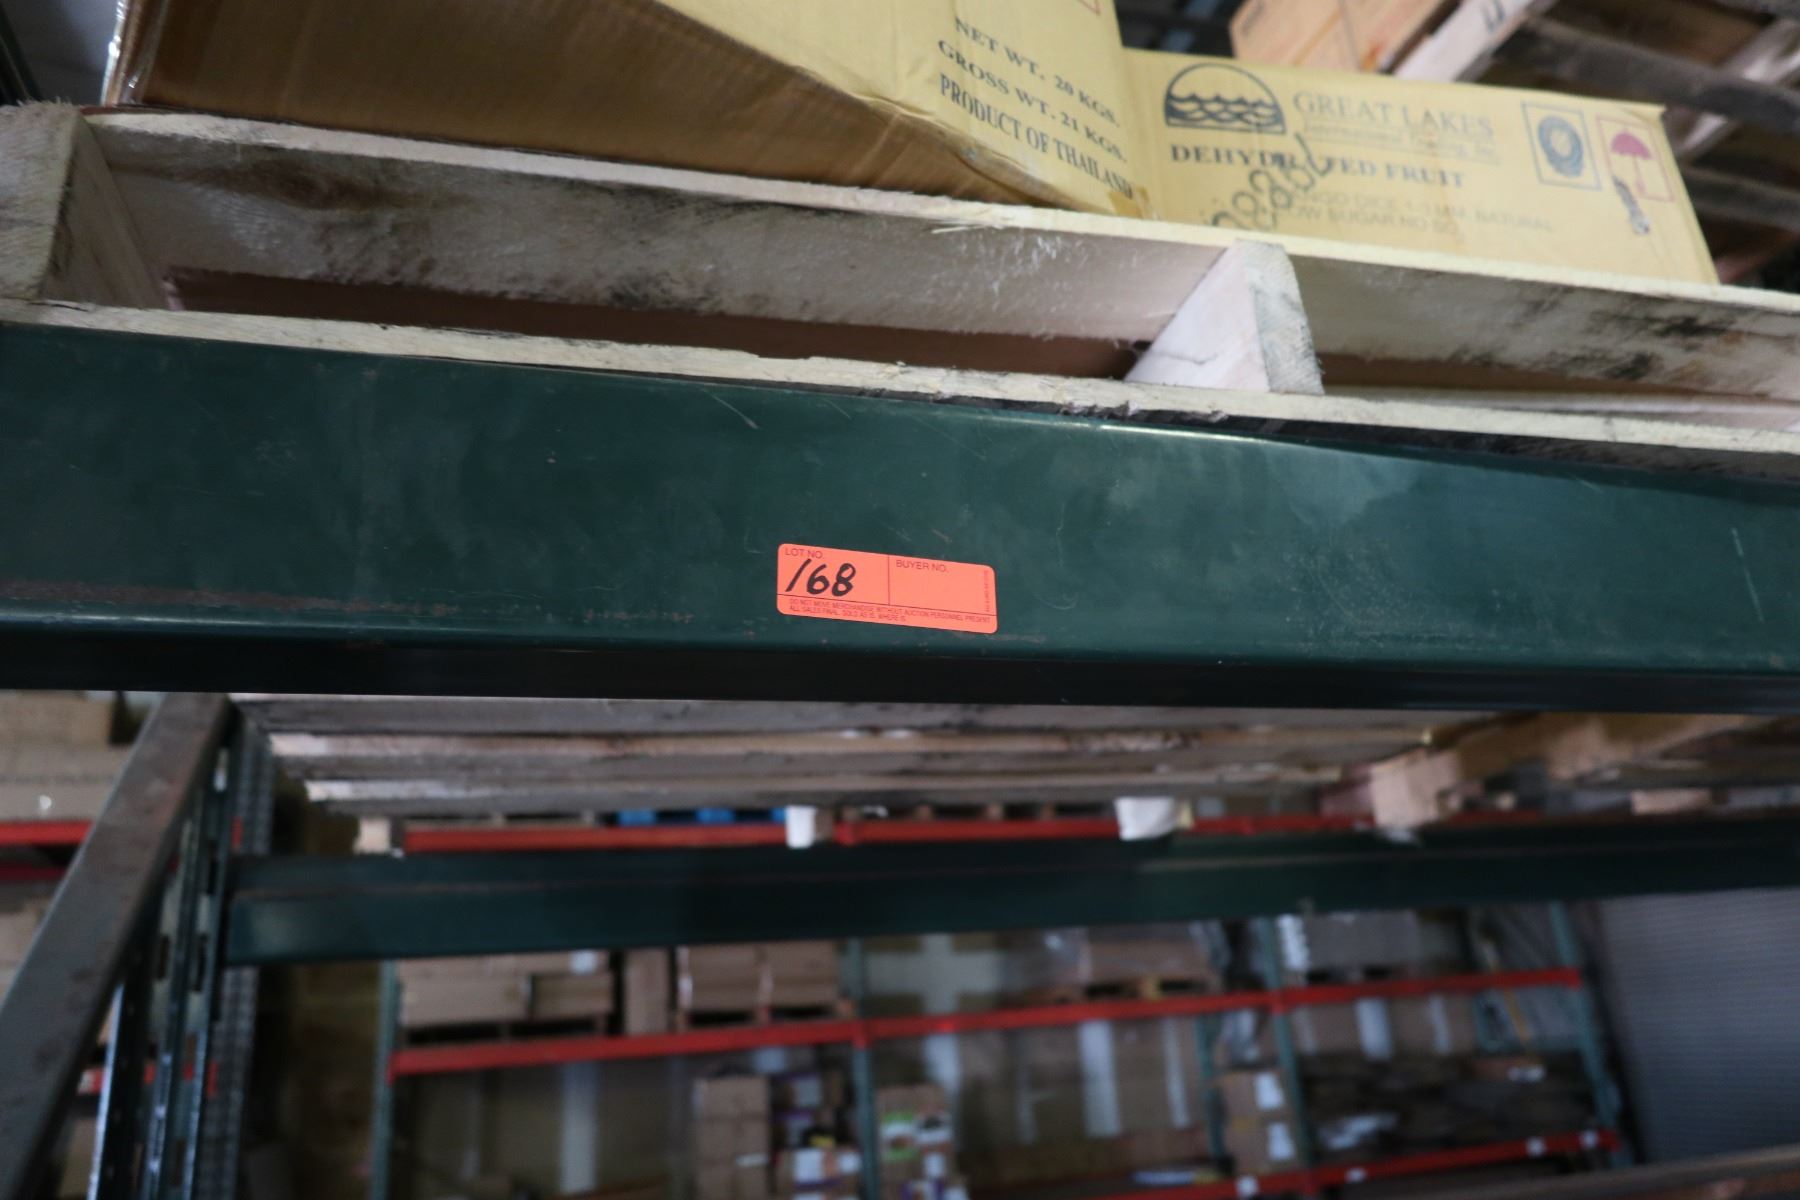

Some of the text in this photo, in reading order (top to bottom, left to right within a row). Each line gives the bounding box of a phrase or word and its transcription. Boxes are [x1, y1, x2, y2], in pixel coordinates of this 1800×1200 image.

[954, 17, 998, 52] NET
[1004, 47, 1045, 81] WT.
[938, 40, 1010, 95] GROSS
[1015, 87, 1056, 119] WT.
[1060, 111, 1079, 132] 21
[939, 73, 1134, 199] PRODUCT OF THAILAND
[1293, 91, 1494, 139] GREAT LAKES
[1384, 164, 1465, 187] FRUIT
[785, 547, 805, 557] LOT
[896, 559, 949, 573] BUYER NO.
[785, 558, 856, 597] 168
